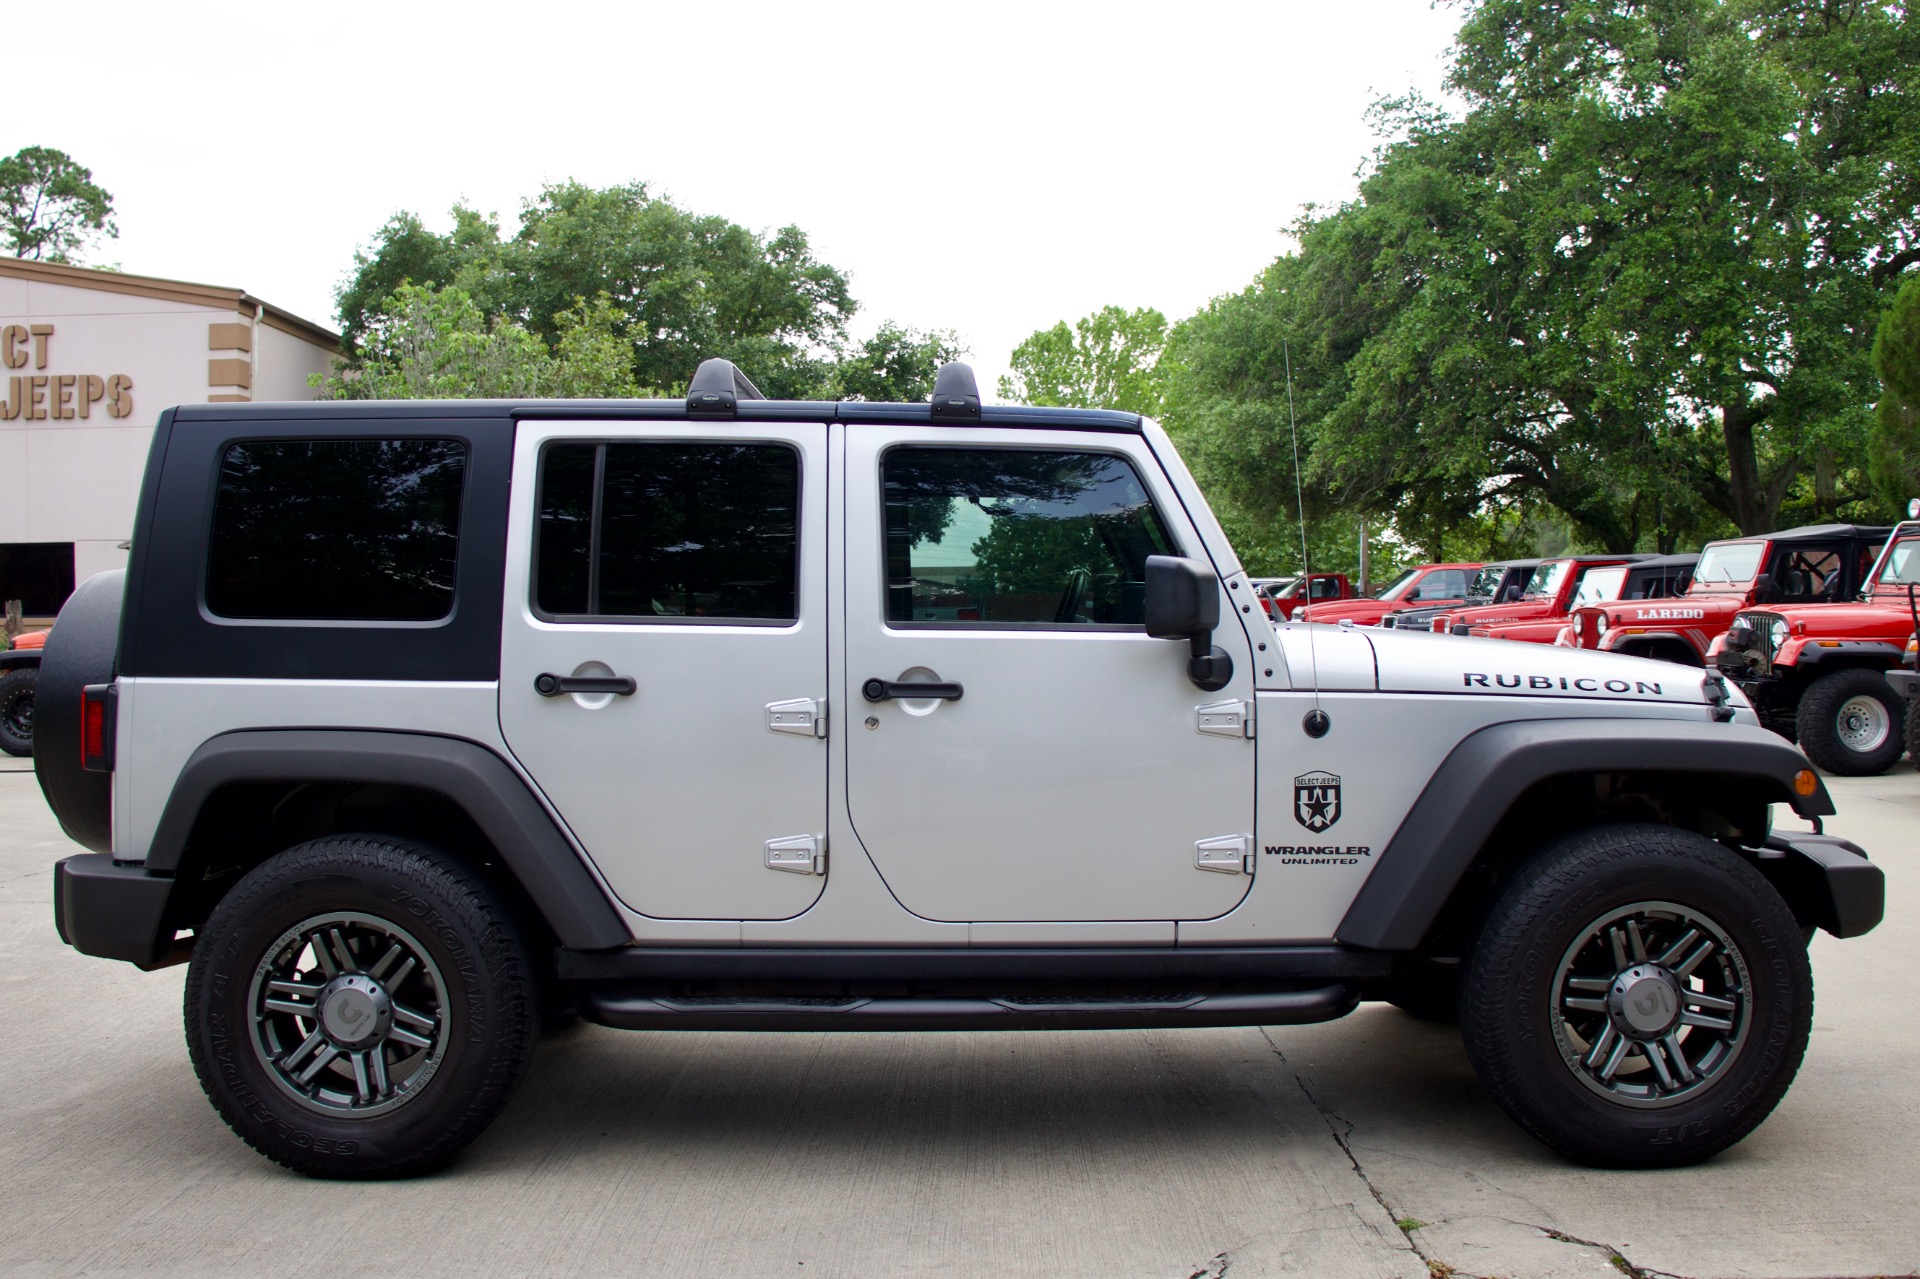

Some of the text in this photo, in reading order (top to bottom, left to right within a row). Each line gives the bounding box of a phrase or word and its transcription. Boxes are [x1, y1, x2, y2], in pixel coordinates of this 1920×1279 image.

[0, 374, 133, 420] JEEPS
[1637, 609, 1704, 619] LAREDO
[1463, 673, 1663, 695] RUBICON
[1264, 846, 1371, 856] WRANGLER
[391, 885, 485, 1044] YOKOHAMA
